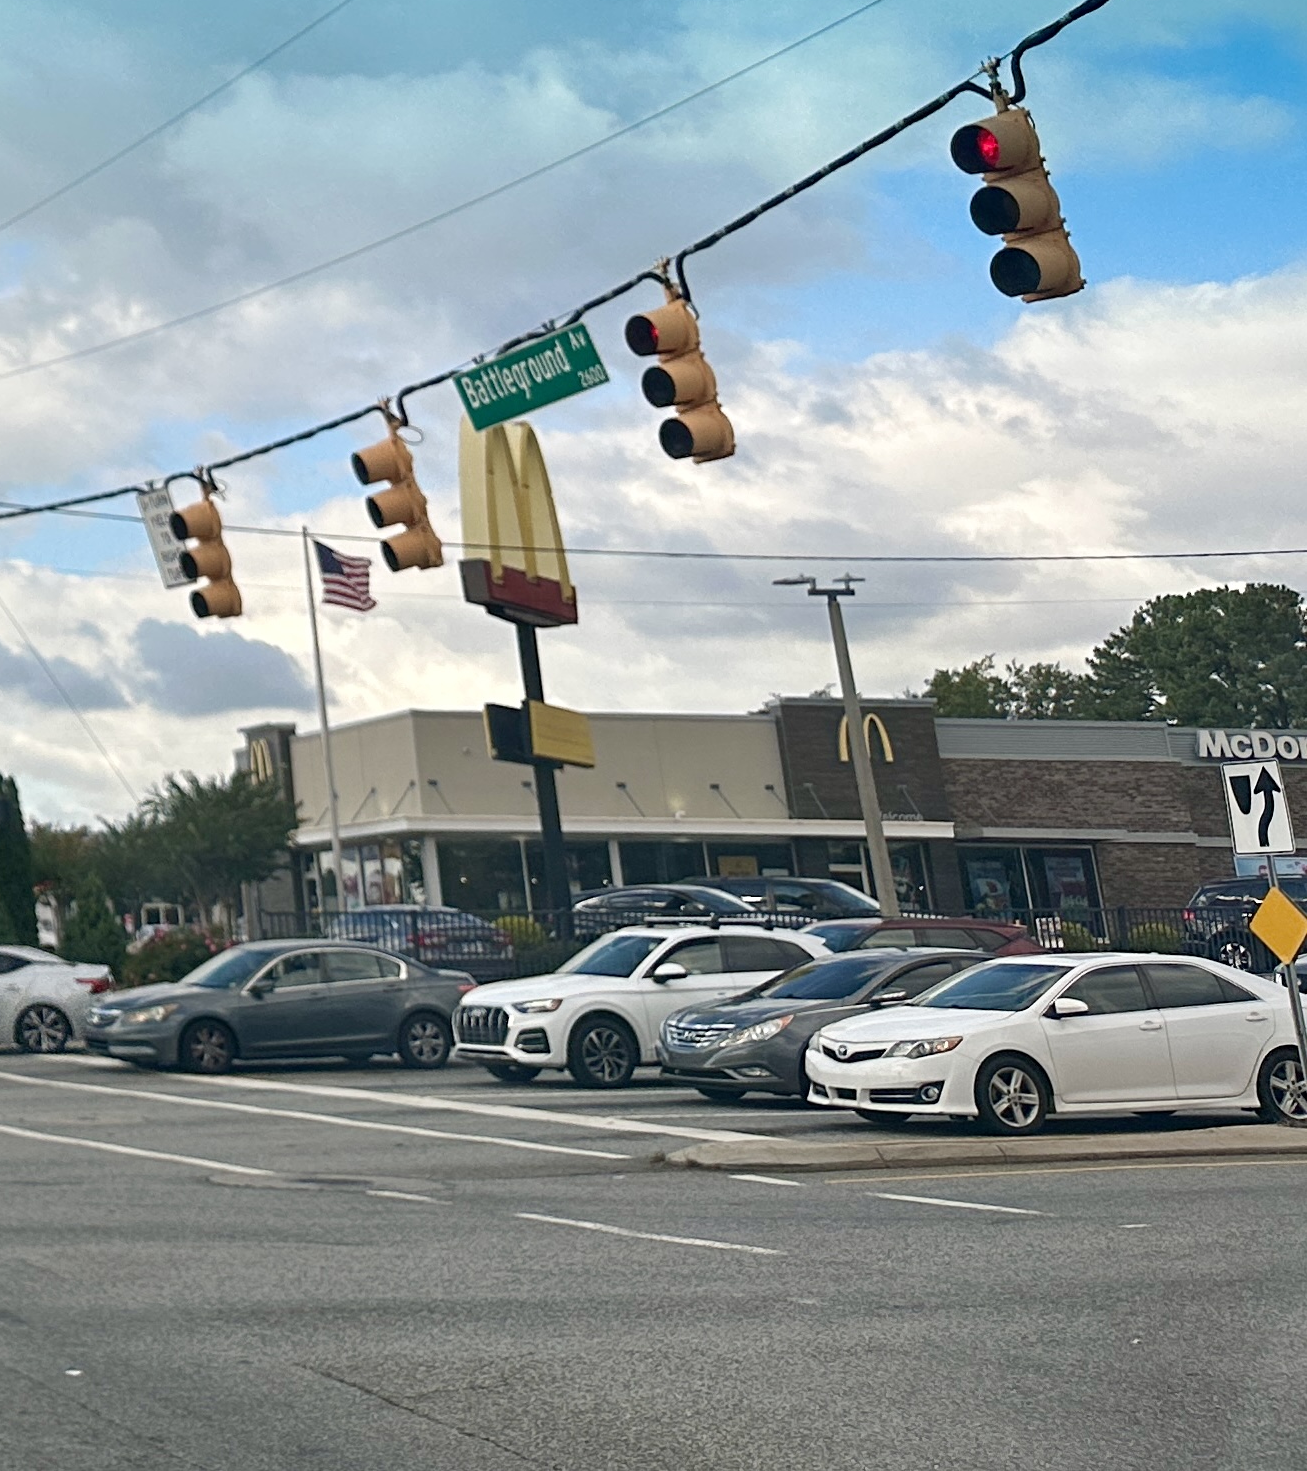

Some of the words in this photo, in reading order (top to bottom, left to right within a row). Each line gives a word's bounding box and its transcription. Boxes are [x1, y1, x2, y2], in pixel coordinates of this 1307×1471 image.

[461, 340, 572, 409] Battleground
[568, 331, 586, 351] Av
[578, 364, 606, 389] 2600
